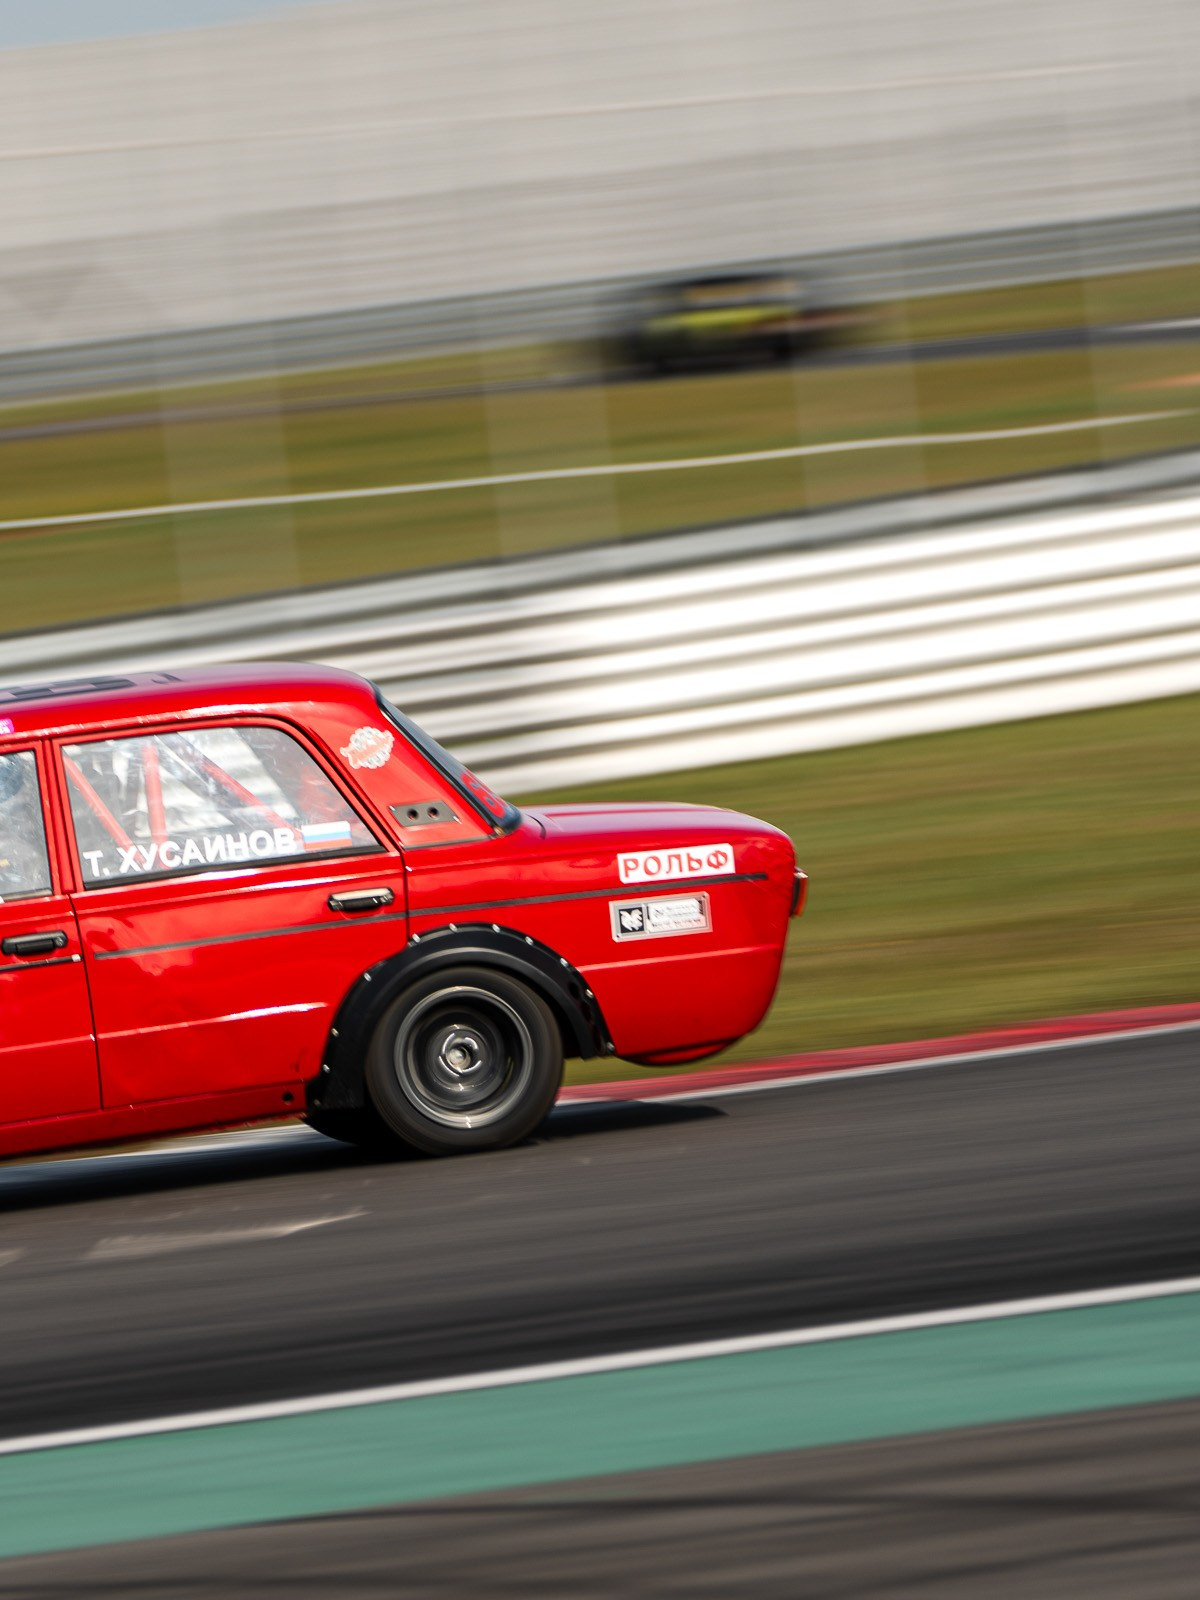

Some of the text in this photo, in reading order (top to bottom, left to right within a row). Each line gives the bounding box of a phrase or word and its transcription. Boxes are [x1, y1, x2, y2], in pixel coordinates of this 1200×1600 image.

[83, 827, 298, 877] Т. ХУСАИНОВ
[623, 849, 728, 878] РОЛЬФ
